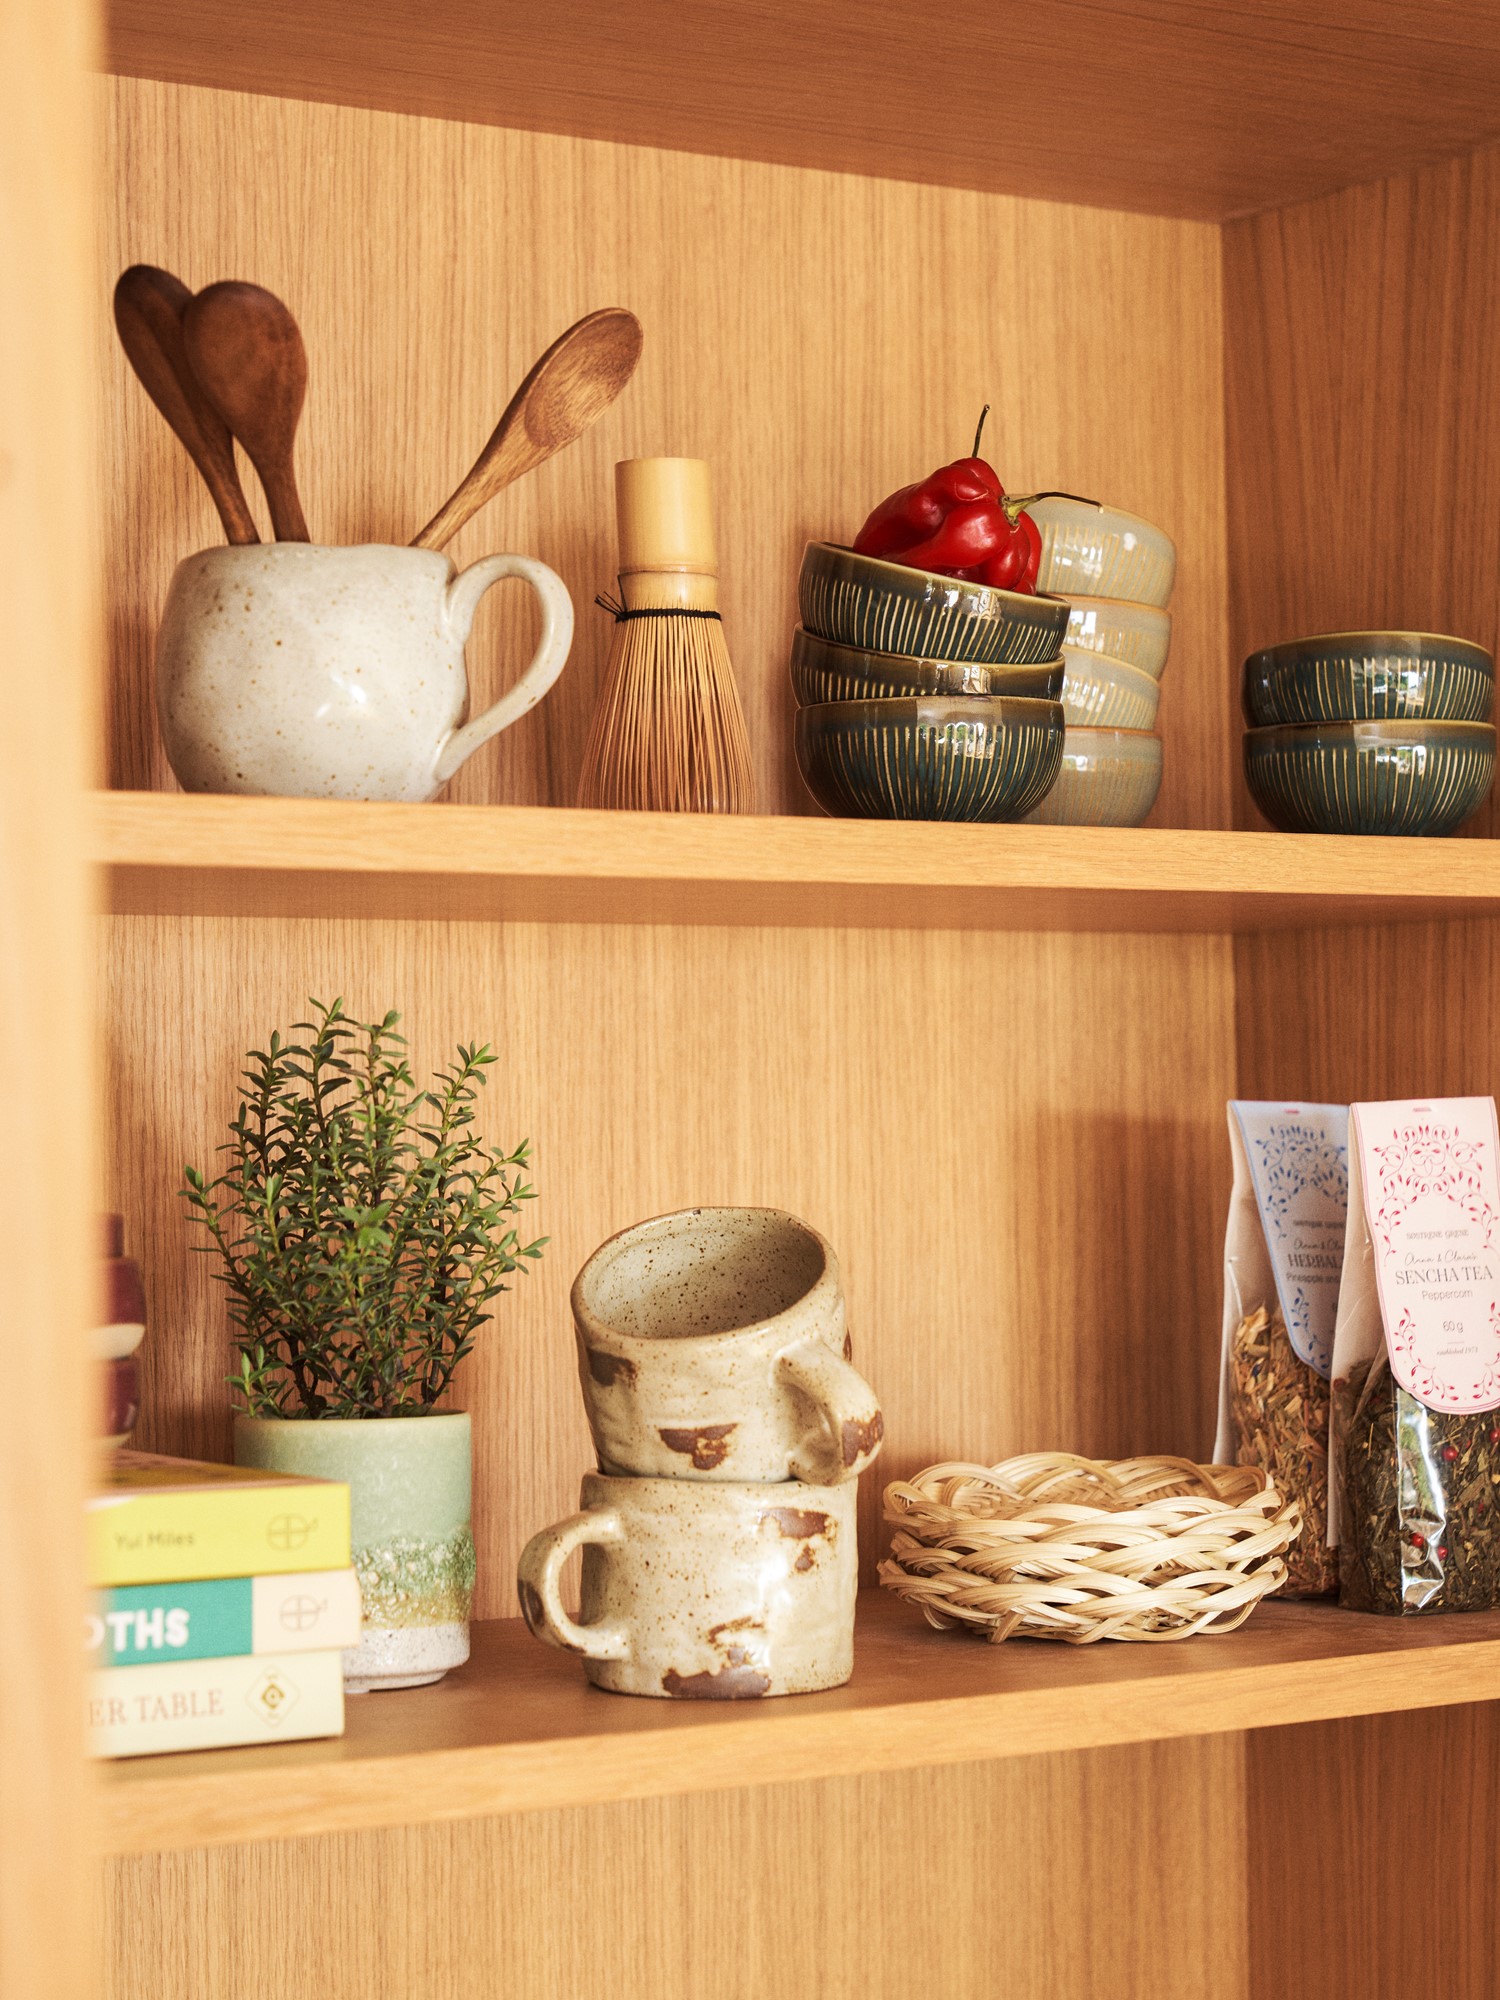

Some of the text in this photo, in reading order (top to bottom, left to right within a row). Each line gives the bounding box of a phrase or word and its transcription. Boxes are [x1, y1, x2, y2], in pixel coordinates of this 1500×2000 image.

[1404, 1252, 1435, 1266] Anna
[1437, 1254, 1442, 1263] &
[1395, 1265, 1494, 1285] SENCHA TEA
[1421, 1288, 1473, 1301] Peppercorn
[1443, 1321, 1464, 1333] 60 g
[146, 1531, 195, 1547] Miles
[134, 1687, 225, 1724] TABLE
